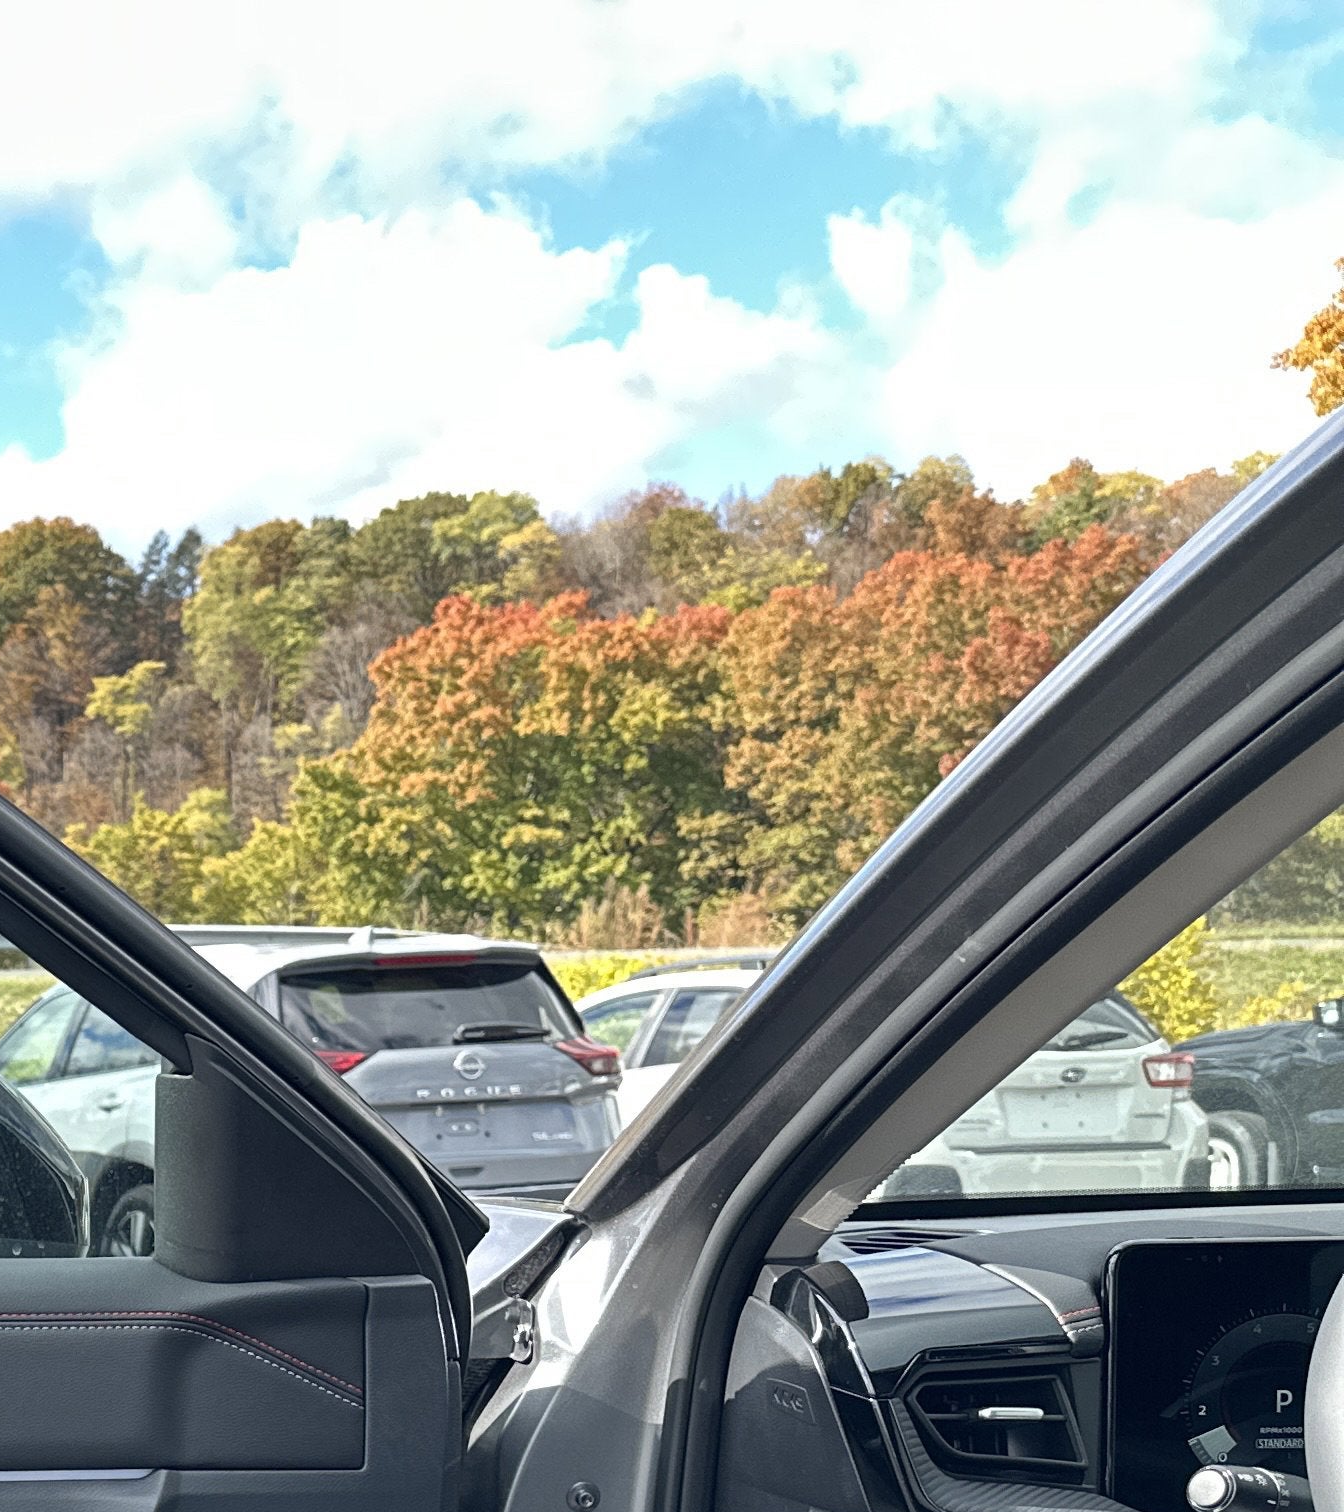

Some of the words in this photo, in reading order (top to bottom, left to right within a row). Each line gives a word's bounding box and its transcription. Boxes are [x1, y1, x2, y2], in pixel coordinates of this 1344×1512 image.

[416, 1084, 522, 1098] ROGUE
[1212, 1355, 1220, 1366] 3
[1276, 1389, 1293, 1413] P
[1198, 1405, 1207, 1416] 2
